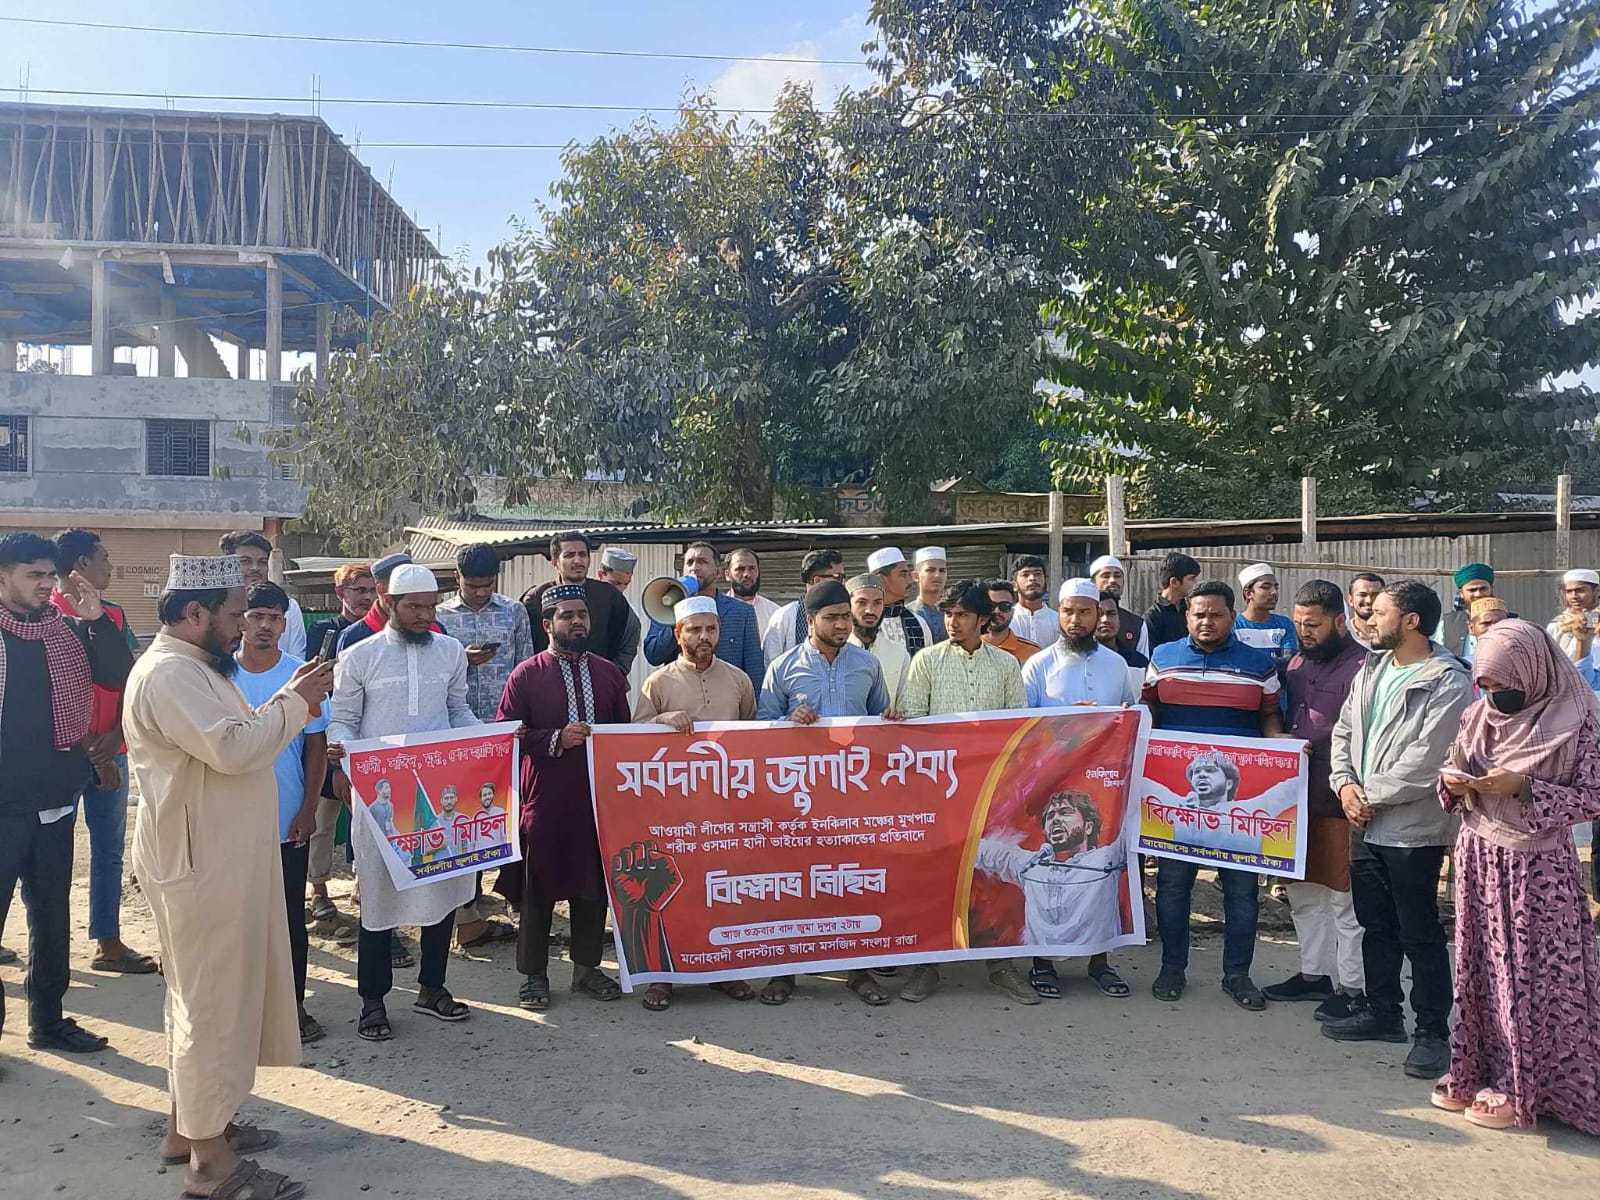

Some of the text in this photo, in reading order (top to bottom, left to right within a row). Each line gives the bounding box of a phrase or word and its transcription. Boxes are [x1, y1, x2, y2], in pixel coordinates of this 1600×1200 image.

[616, 740, 959, 816] সর্বদলীয় জুলাই ঐক্য
[452, 810, 509, 846] মিছিল
[648, 821, 697, 838] আওয়ামী
[700, 820, 735, 836] লীগের
[811, 815, 860, 832] ইনকিলাব
[897, 811, 937, 828] মুখপাত্র
[1145, 795, 1296, 843] বিক্ষোভ মিছিল
[665, 838, 698, 855] শরীফ
[701, 838, 740, 853] ওসমান
[743, 833, 767, 849] হাদী
[879, 828, 926, 844] প্রতিবাদে
[705, 862, 887, 908] বিক্ষোভ মিছিল
[721, 930, 741, 941] আজ
[778, 923, 794, 935] বাদ
[817, 921, 838, 934] দুপুর
[680, 947, 732, 966] মনোহরদী
[788, 941, 816, 956] জামে
[819, 935, 857, 953] মসজিদ
